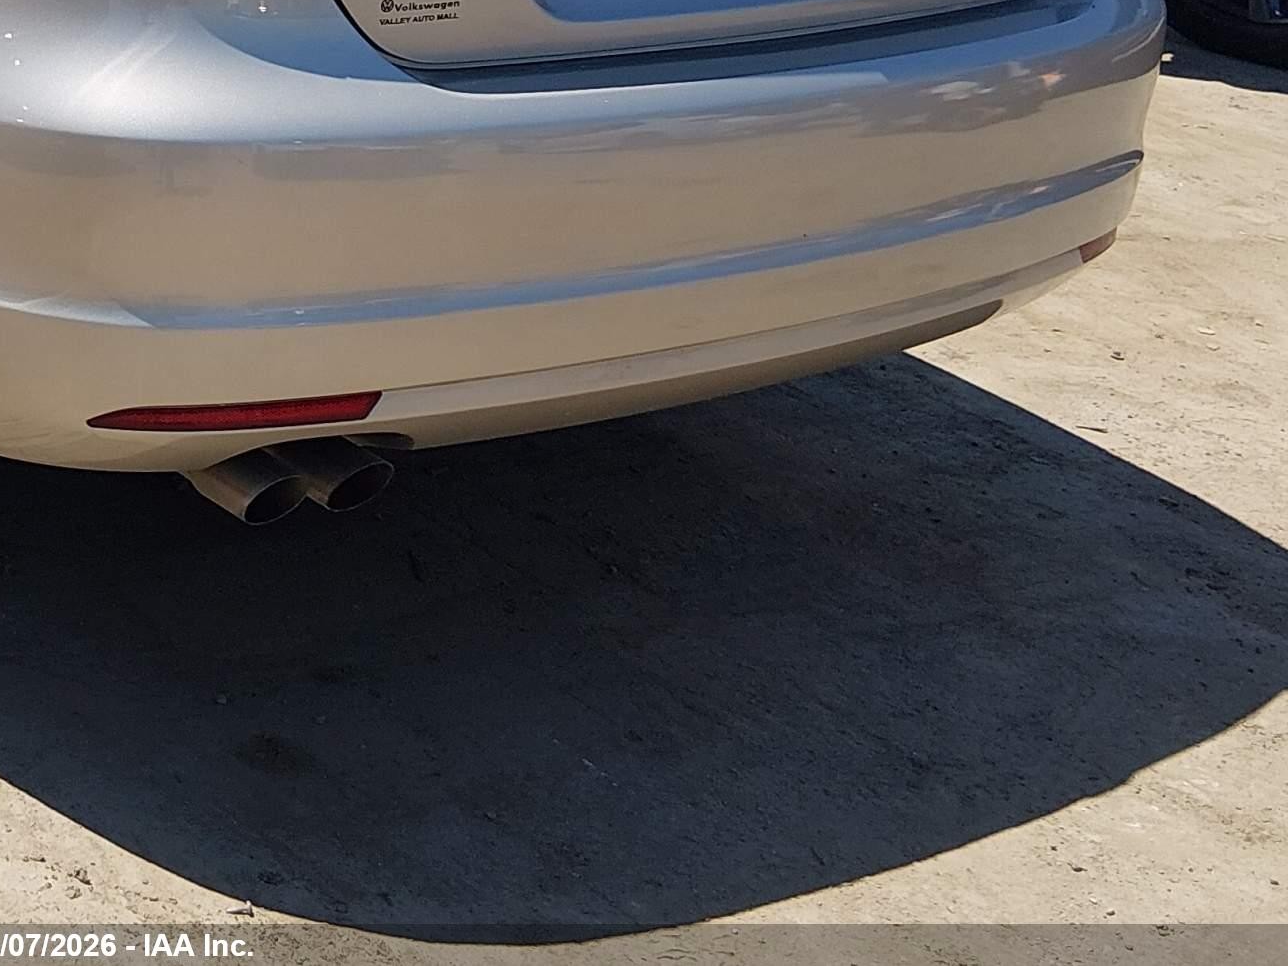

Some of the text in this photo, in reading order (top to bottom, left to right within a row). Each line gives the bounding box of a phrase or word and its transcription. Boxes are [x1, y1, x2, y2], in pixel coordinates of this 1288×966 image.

[394, 0, 460, 13] Volkswagen
[379, 12, 459, 26] VALLEY AUTO MALL
